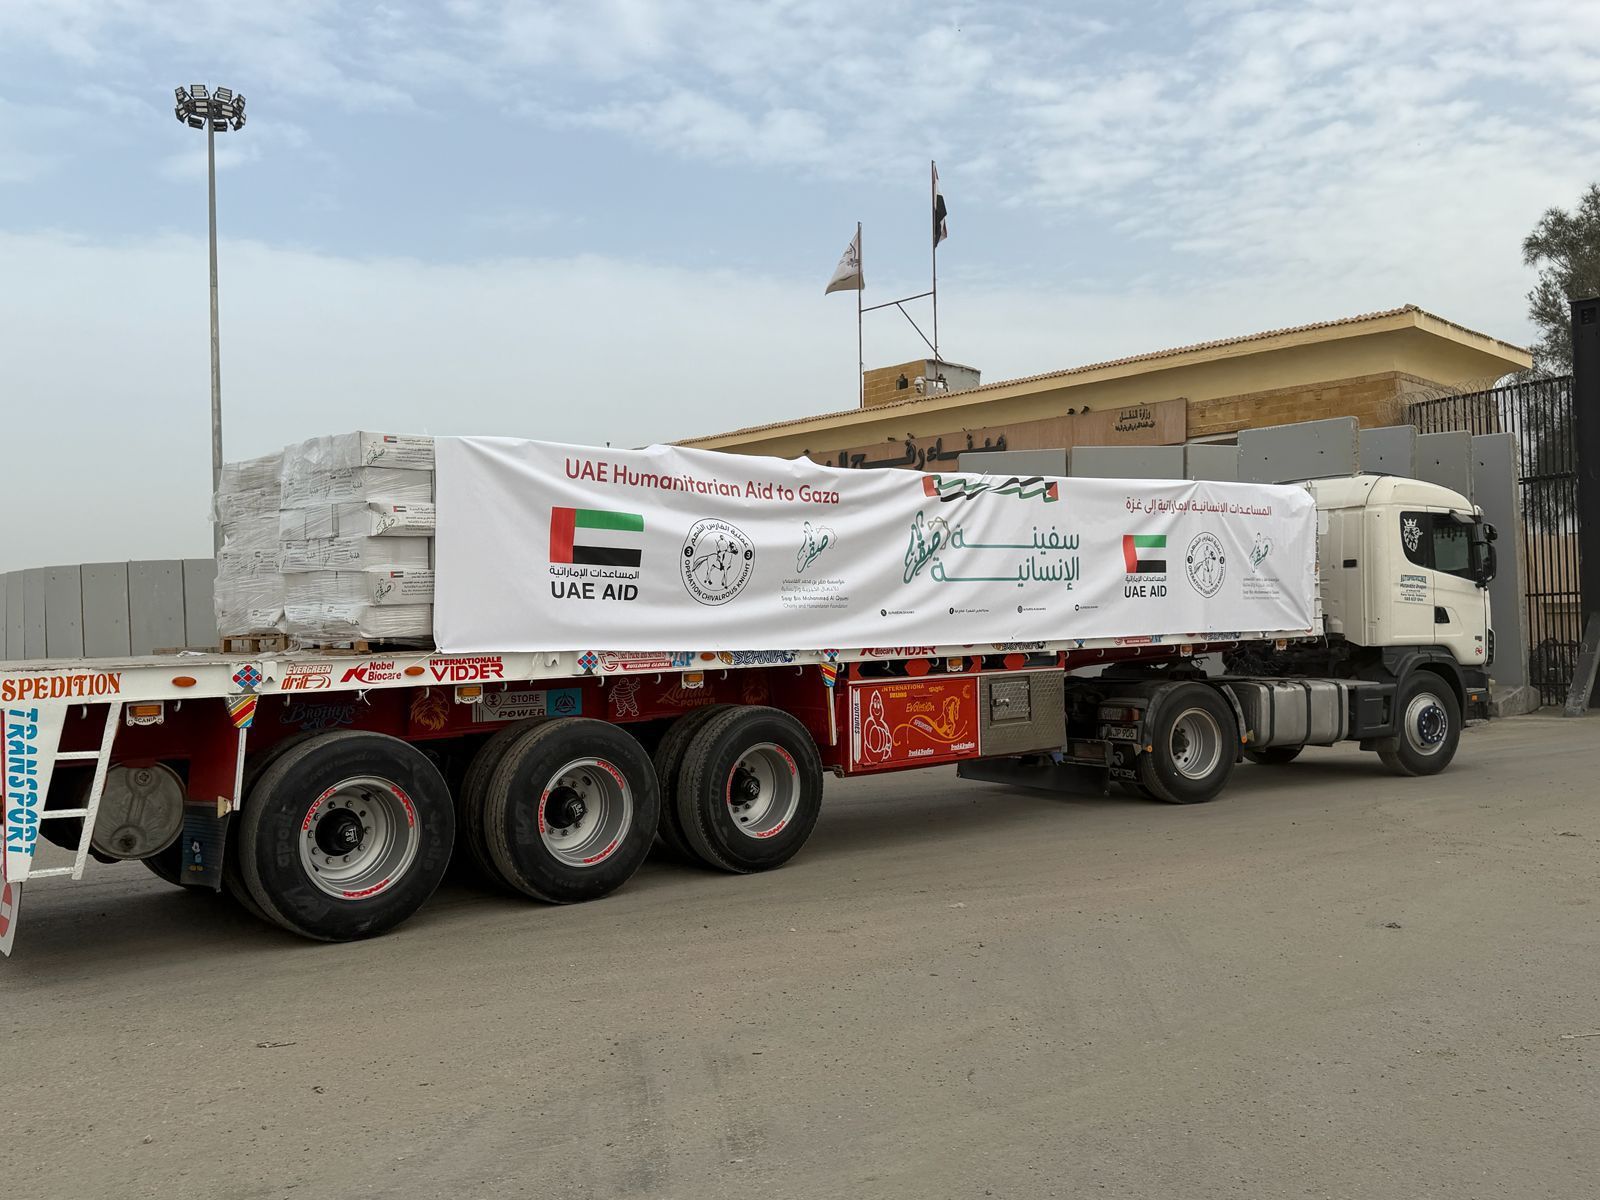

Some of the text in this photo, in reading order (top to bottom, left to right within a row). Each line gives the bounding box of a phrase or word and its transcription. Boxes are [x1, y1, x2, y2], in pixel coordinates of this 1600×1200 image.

[565, 458, 841, 505] UAE Humanitarian Aid to Gaza
[1126, 496, 1143, 513] غزة
[1144, 499, 1157, 516] إلى
[1192, 499, 1229, 517] الإنسانية
[1229, 503, 1272, 517] المساعدات
[706, 522, 730, 532] الفارس
[730, 528, 749, 549] عملية
[951, 524, 1080, 555] سفينة
[549, 566, 640, 580] المساعدات الإماراتية
[684, 559, 751, 602] OPERATION CHIVALROUS KNIGHT
[930, 555, 1080, 591] الإنسانية
[550, 580, 639, 602] UAE AID
[1124, 584, 1167, 599] UAE AID
[369, 661, 395, 672] Nobel
[429, 656, 503, 667] INTERNATIONALE
[281, 674, 310, 690] drift
[368, 671, 402, 682] Biocare
[2, 672, 122, 701] SPEDITION
[511, 694, 540, 703] STORE
[499, 708, 545, 719] POWER
[6, 707, 39, 857] TRANSPORT
